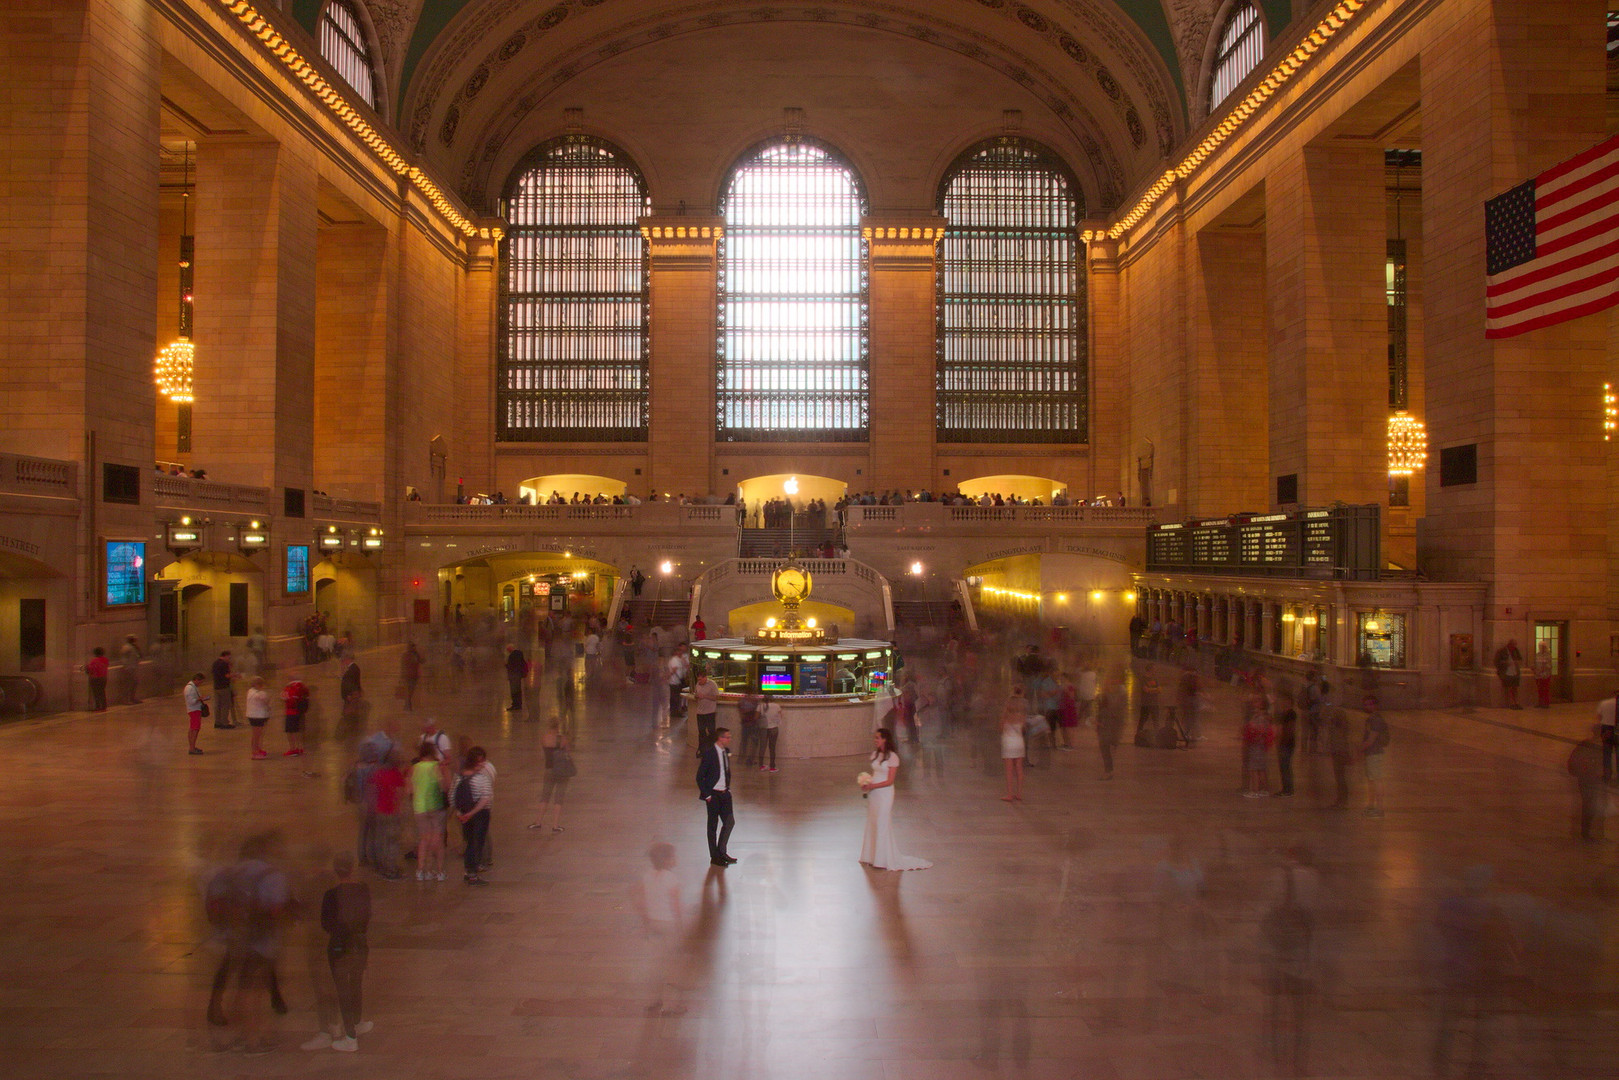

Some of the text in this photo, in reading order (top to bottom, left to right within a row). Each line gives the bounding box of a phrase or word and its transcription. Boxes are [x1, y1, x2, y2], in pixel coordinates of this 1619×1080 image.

[10, 538, 41, 555] STREET
[466, 547, 493, 557] TRACKS
[584, 550, 597, 558] AVE
[986, 544, 1042, 559] LEXINGTON AVE
[1066, 545, 1127, 561] TICKET MACHINES
